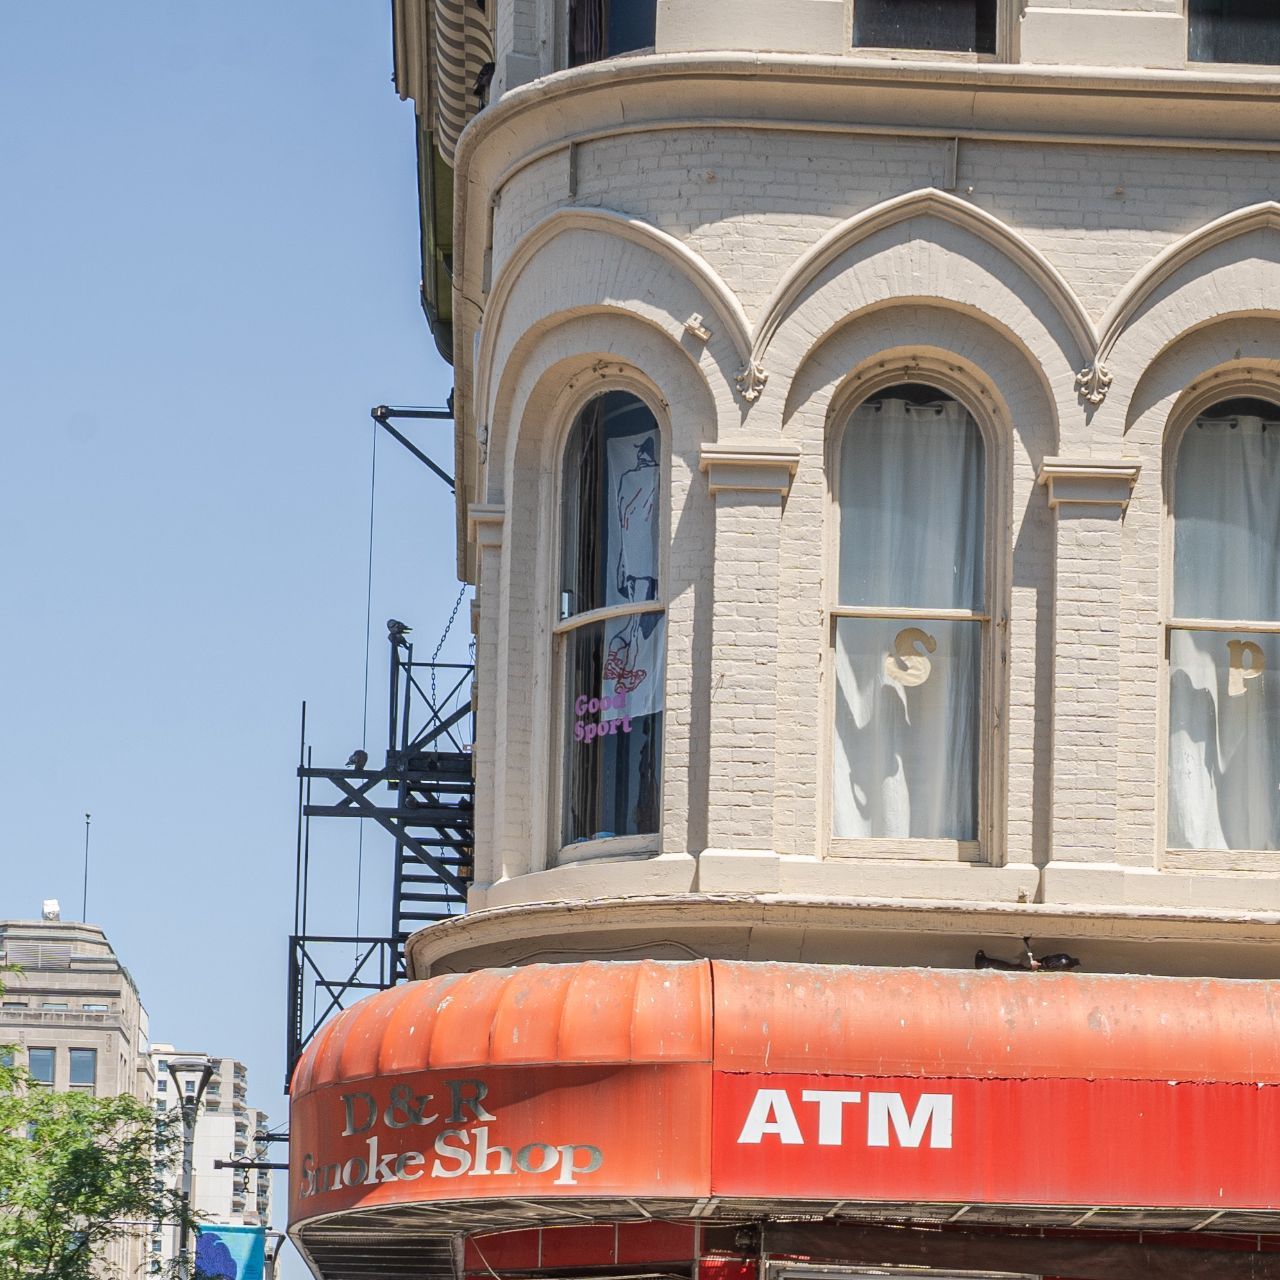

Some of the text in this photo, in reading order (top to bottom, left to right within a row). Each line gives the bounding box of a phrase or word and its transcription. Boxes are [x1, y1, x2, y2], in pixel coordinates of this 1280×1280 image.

[575, 688, 626, 716] Good
[574, 714, 632, 744] Sport
[736, 1088, 954, 1149] ATM
[299, 1126, 604, 1199] Smoke Shop
